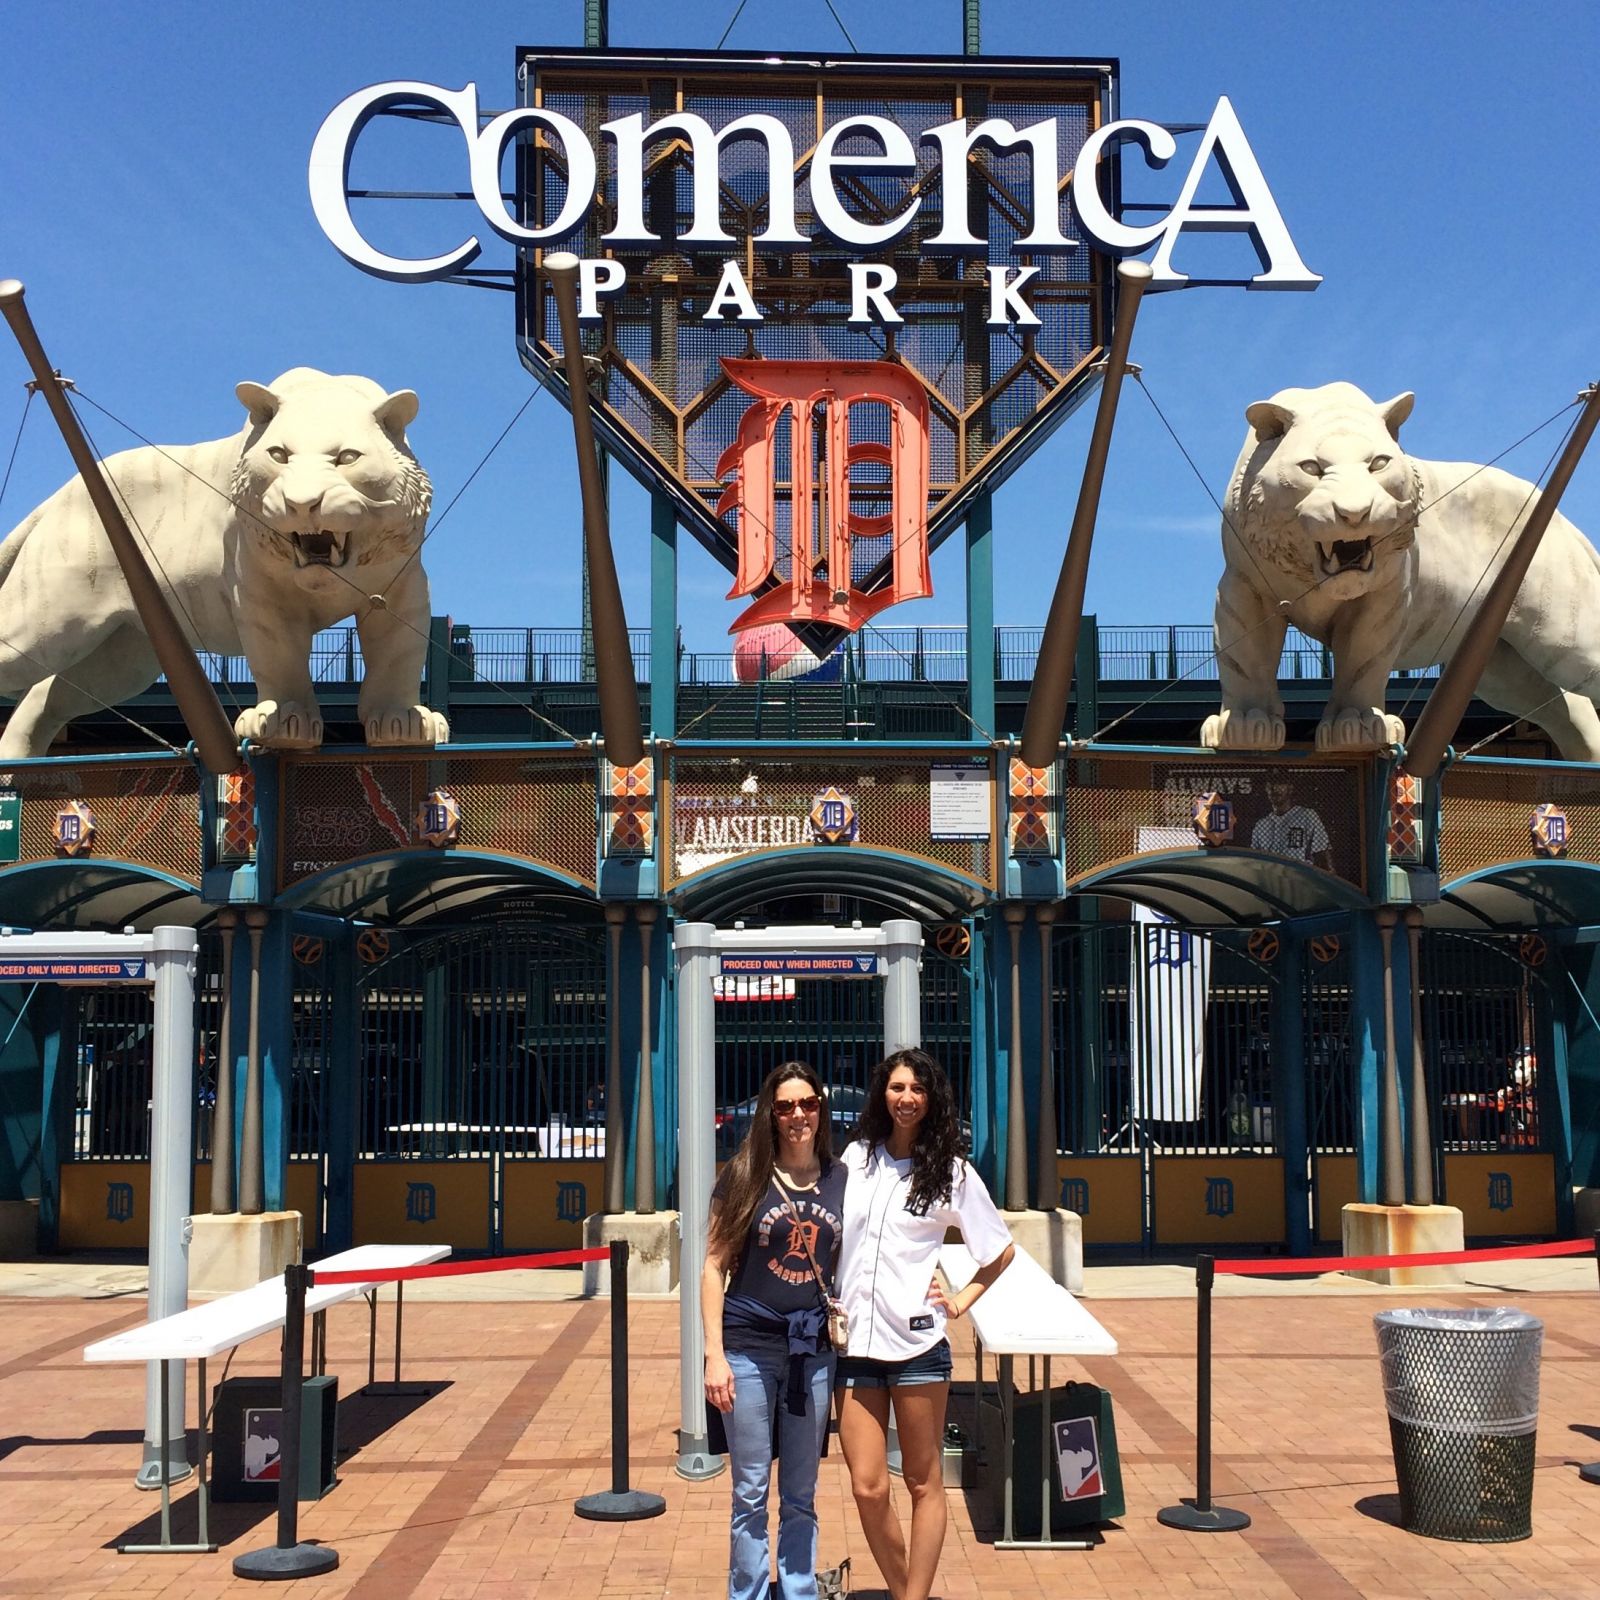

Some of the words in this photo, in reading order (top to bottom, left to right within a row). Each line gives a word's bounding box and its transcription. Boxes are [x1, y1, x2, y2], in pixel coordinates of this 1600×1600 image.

[577, 258, 1043, 326] PARK
[1164, 777, 1252, 795] ALWAYS
[693, 816, 822, 847] AMSTERDA
[502, 900, 536, 909] NOTICE
[27, 965, 49, 975] ONLY
[51, 965, 77, 975] WHEN
[79, 964, 121, 974] DIRECTED
[723, 960, 761, 969] PROCEED
[764, 960, 784, 969] ONLY
[786, 960, 811, 969] WHEN
[813, 960, 853, 969] DIRECTED
[758, 1201, 806, 1247] DETROIT
[811, 1202, 842, 1252] TIGERS
